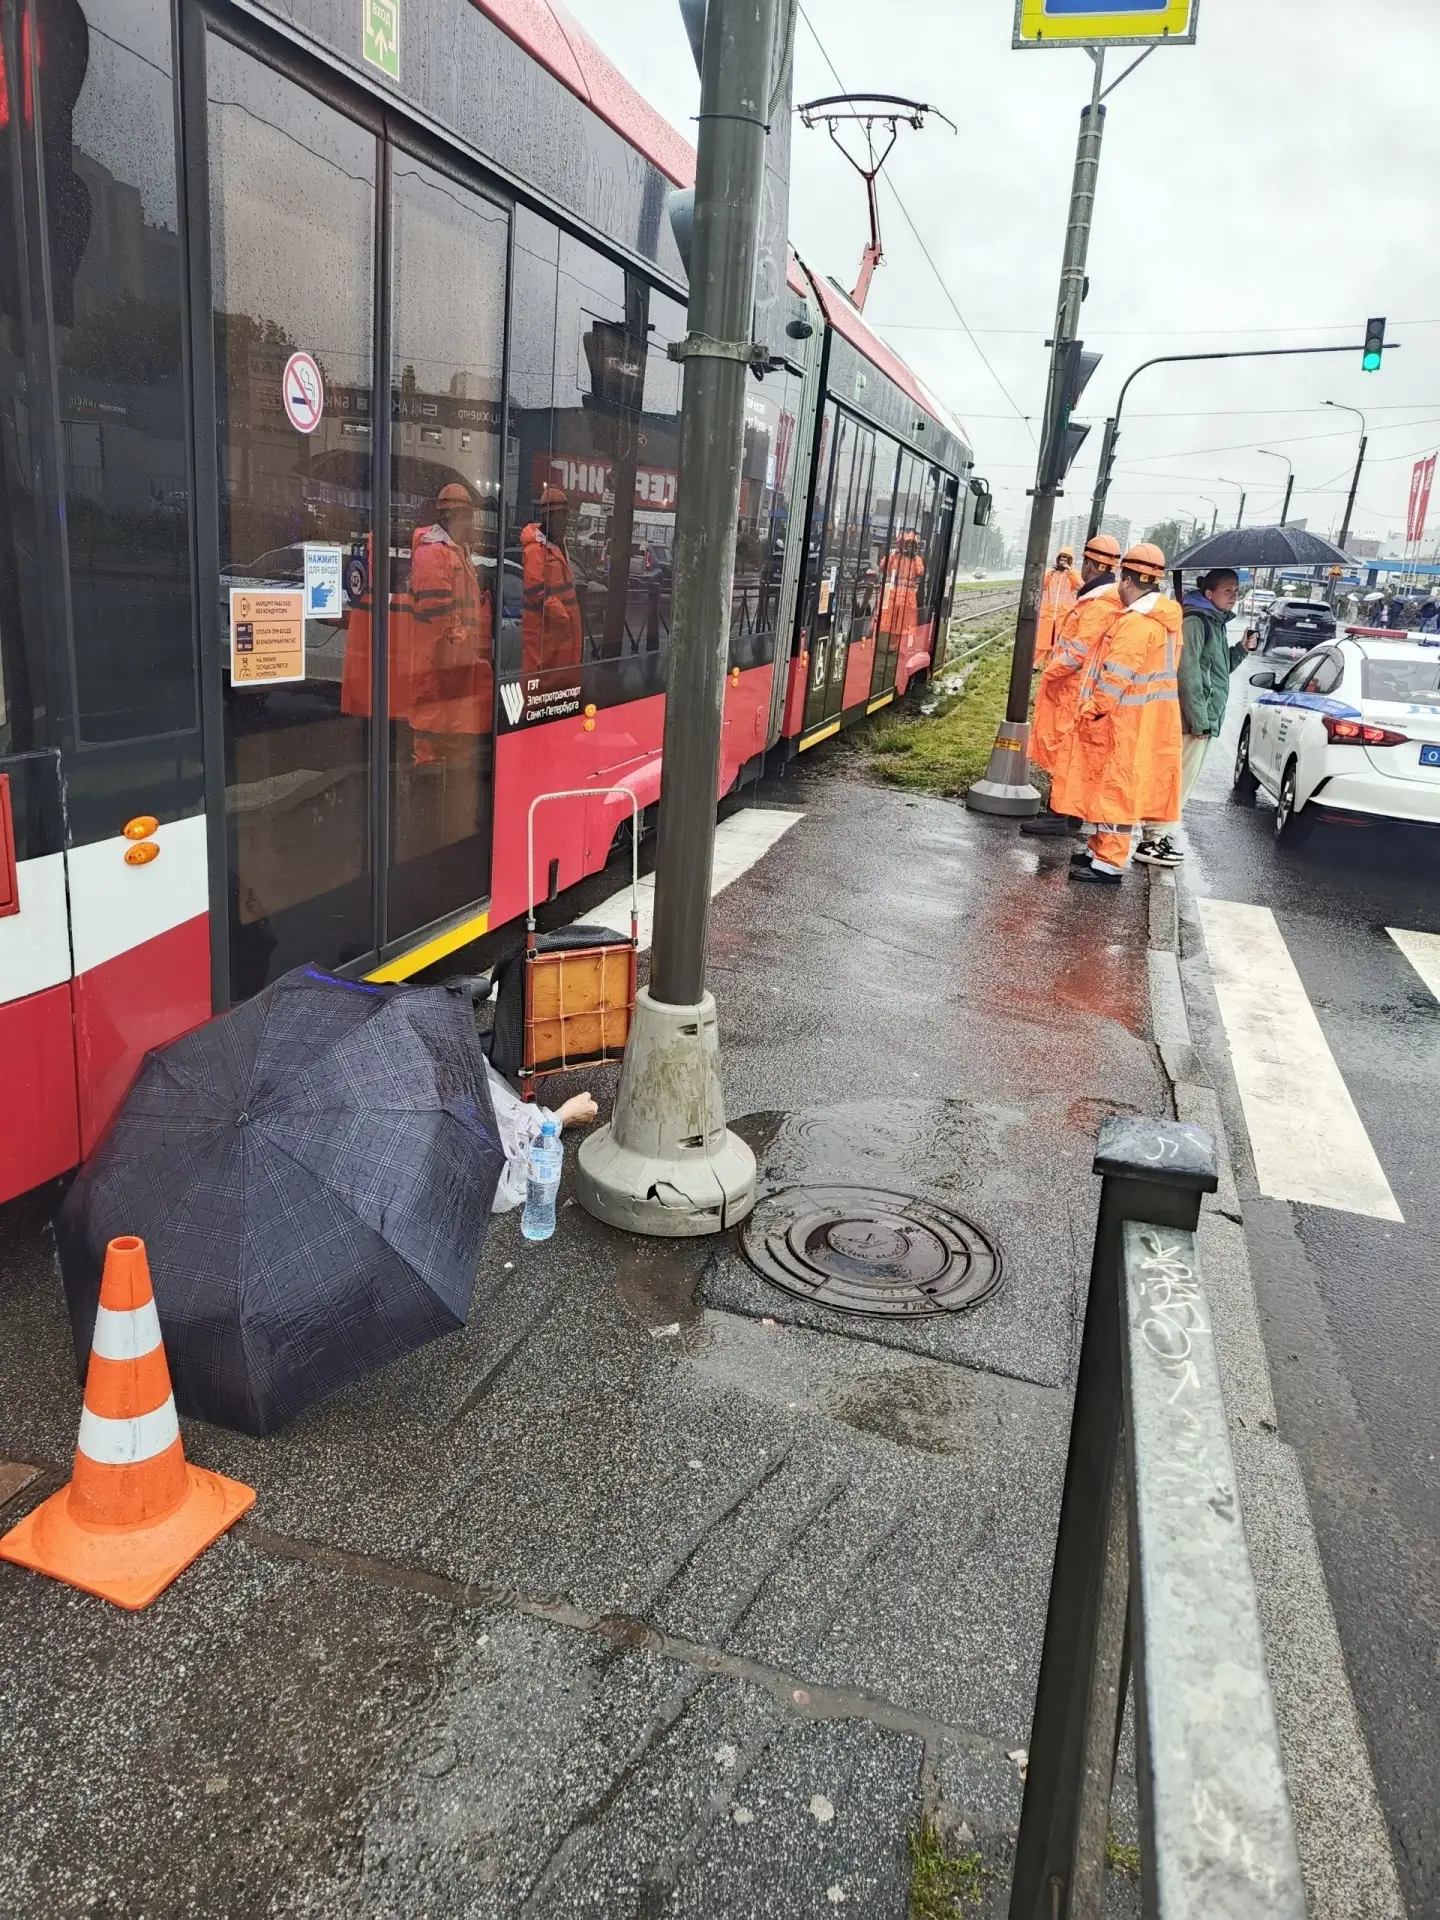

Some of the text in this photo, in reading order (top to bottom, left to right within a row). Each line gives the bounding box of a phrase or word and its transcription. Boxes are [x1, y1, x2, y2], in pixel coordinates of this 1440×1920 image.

[308, 554, 338, 564] НАЖМИТЕ
[527, 679, 540, 691] ГЭТ
[526, 686, 582, 707] Электротранспорт
[526, 700, 580, 721] Санкт-Петербурга
